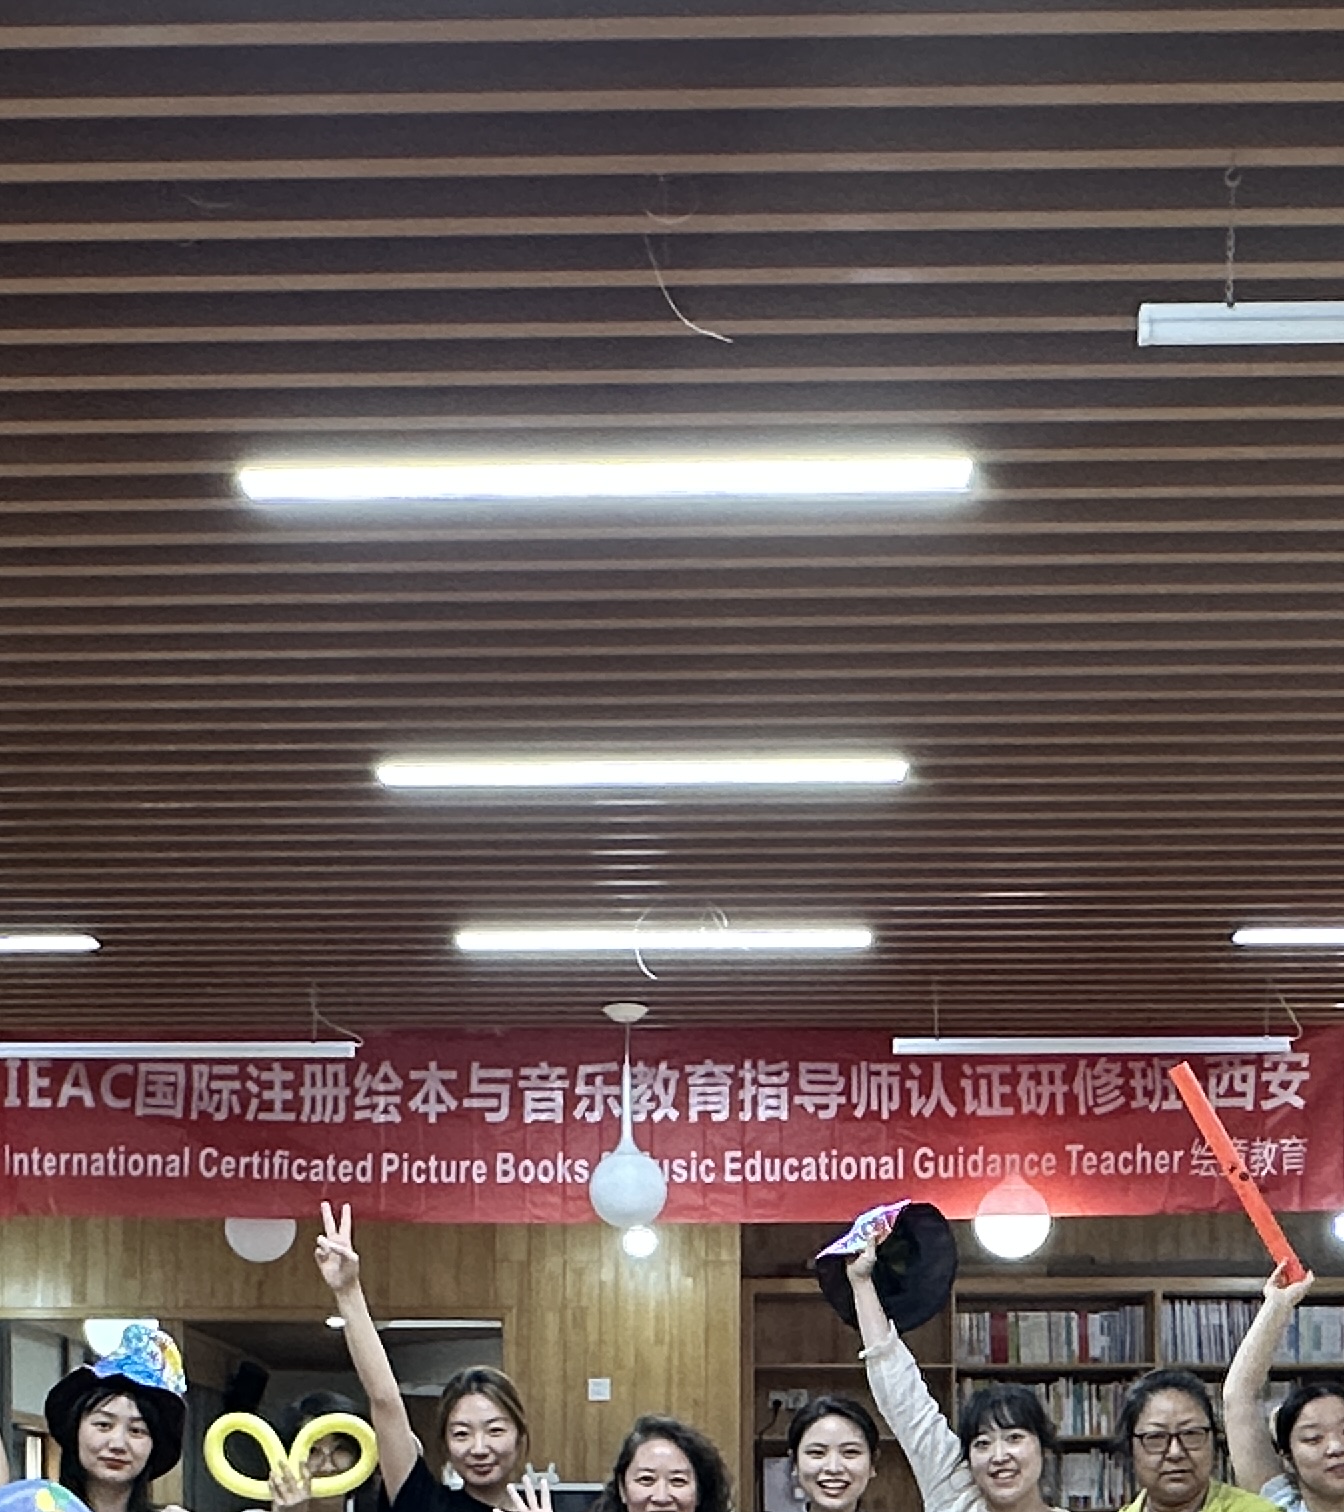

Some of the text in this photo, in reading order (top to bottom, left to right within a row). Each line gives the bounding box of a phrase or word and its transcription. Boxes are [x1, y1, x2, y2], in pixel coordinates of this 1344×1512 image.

[3, 1144, 190, 1178] International
[198, 1146, 374, 1183] Certificated
[380, 1152, 488, 1184] Picture
[496, 1151, 590, 1184] Books
[638, 1150, 716, 1184] usic
[723, 1147, 904, 1184] Educational
[912, 1146, 1057, 1180] Guidance
[1064, 1142, 1185, 1175] Teacher
